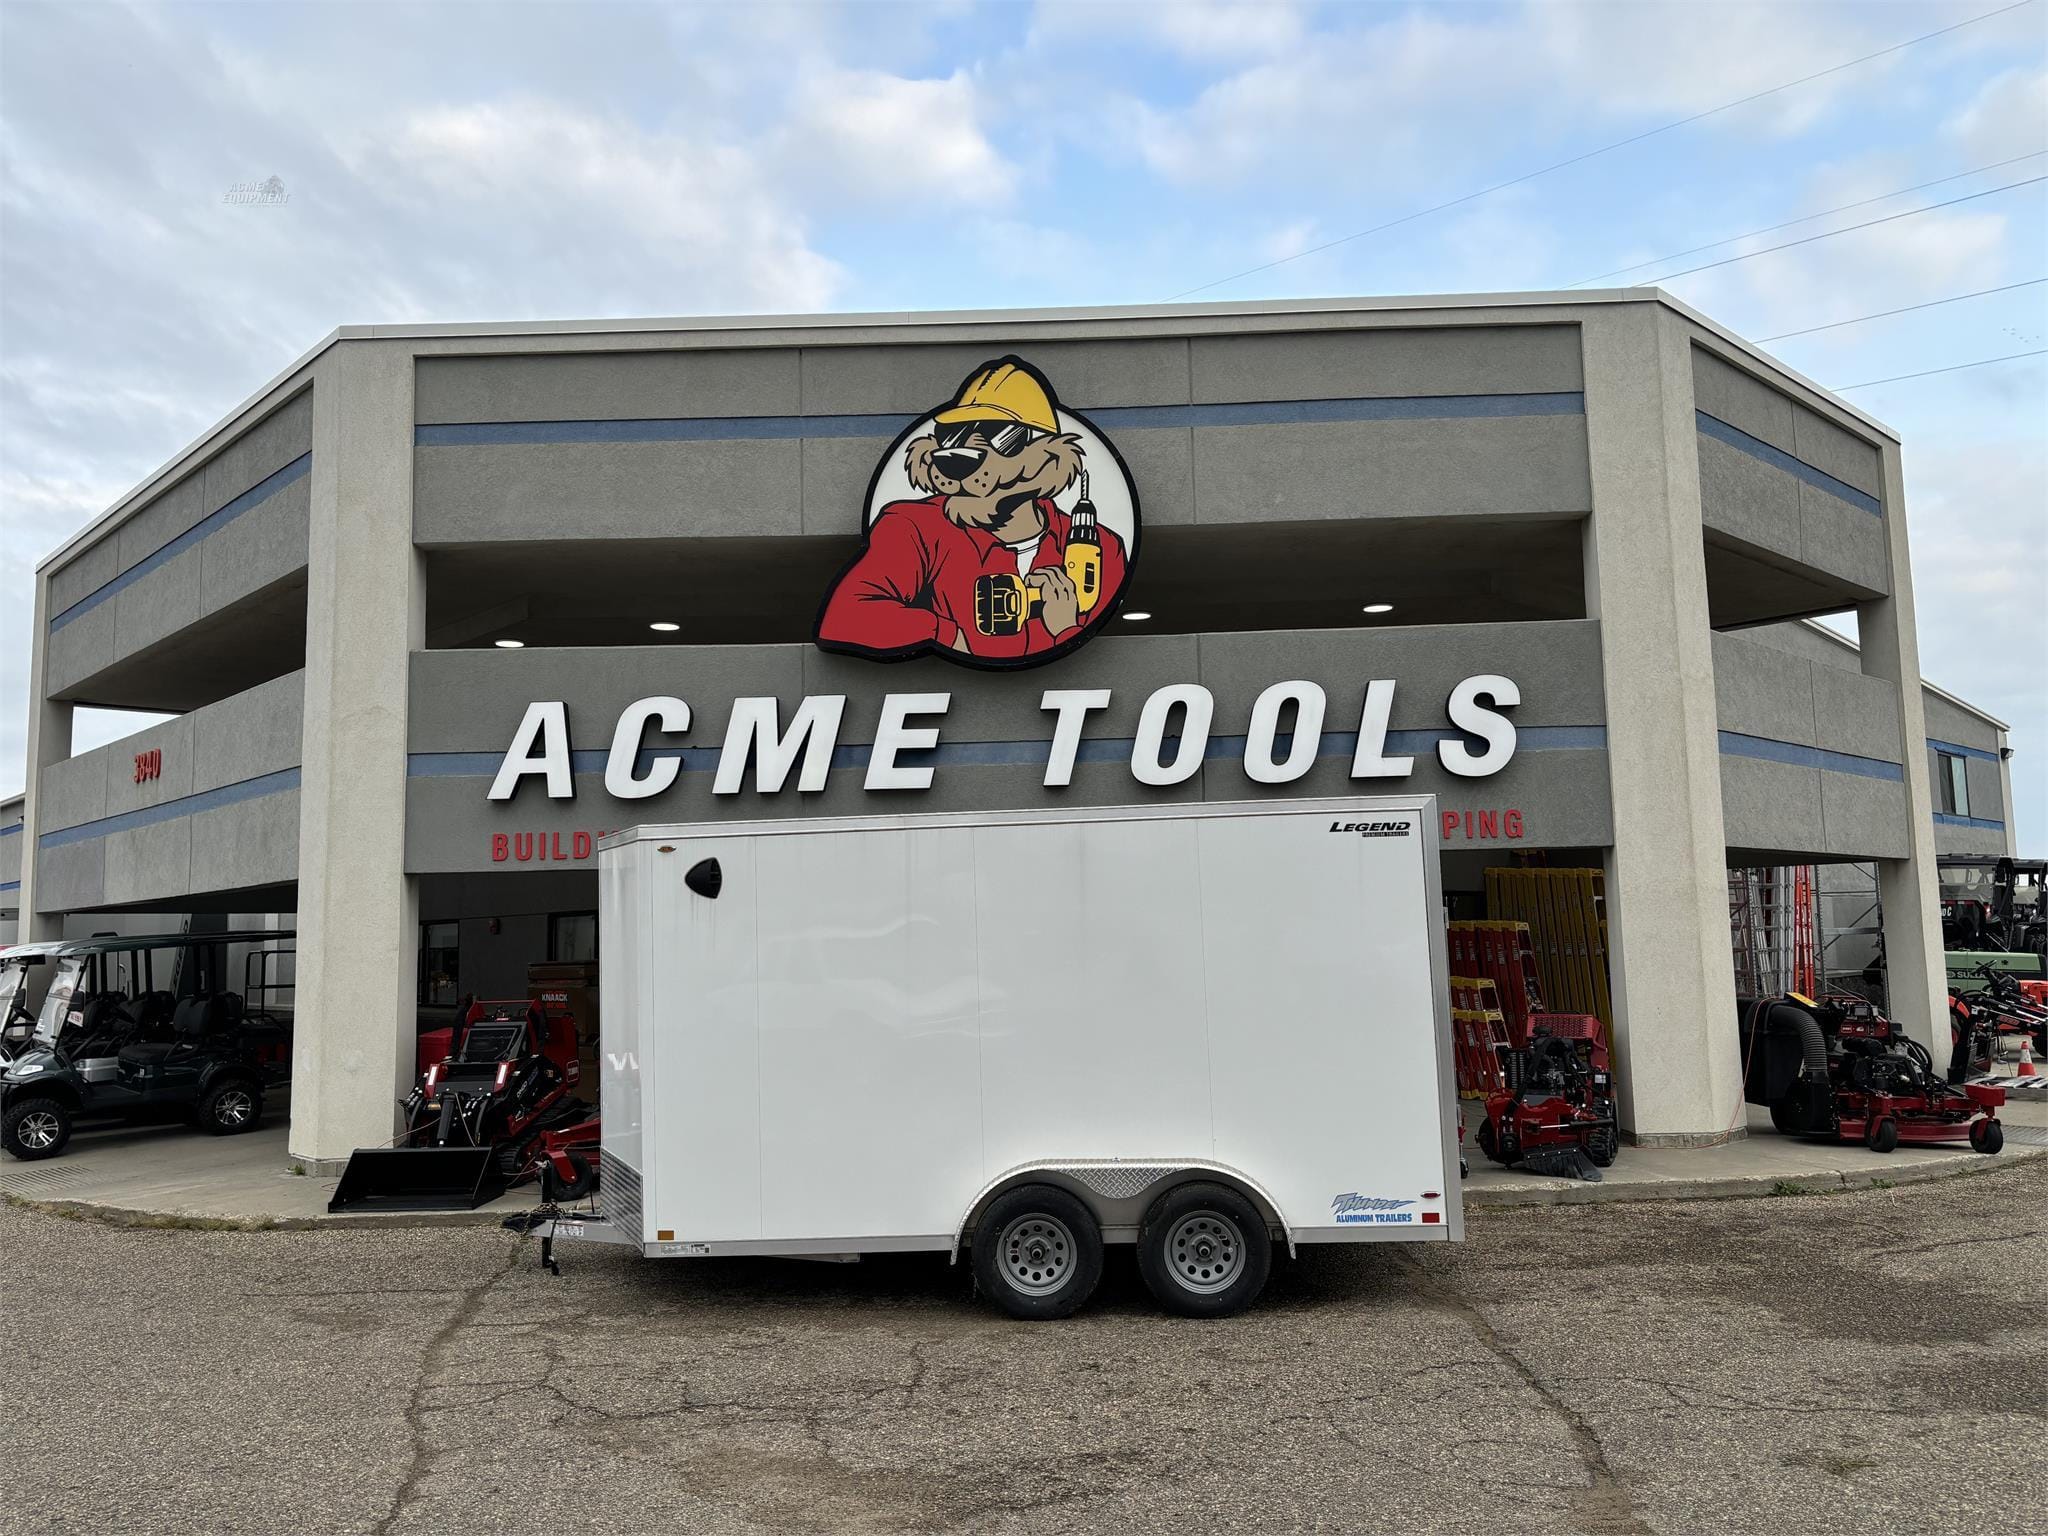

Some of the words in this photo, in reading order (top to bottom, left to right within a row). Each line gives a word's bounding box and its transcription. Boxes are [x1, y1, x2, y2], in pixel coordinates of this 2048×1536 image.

[485, 692, 952, 801] ACME
[1040, 673, 1521, 788] TOOLS
[492, 829, 621, 861] BUILD
[1442, 808, 1525, 840] PING
[1329, 821, 1411, 833] LEGEND
[1335, 1214, 1374, 1223] ALUMINUM
[1375, 1213, 1413, 1223] TRAILERS
